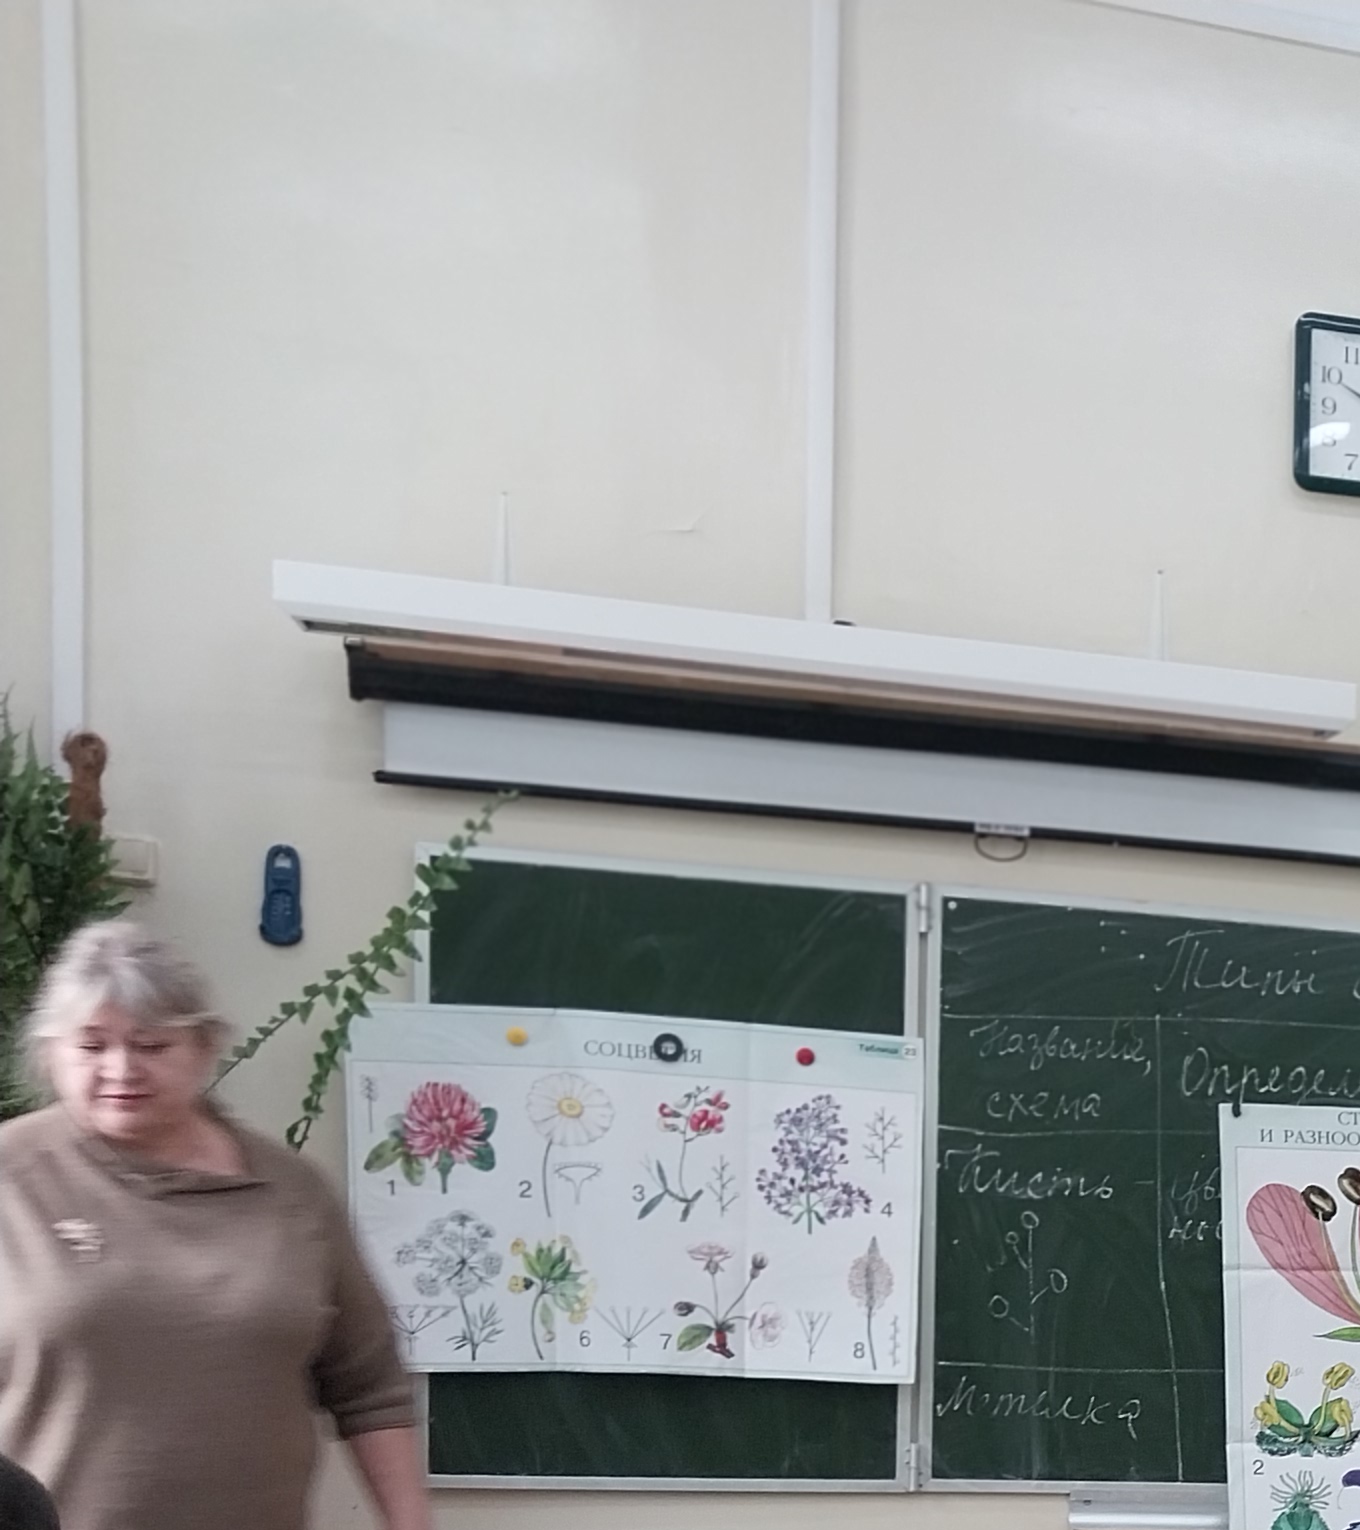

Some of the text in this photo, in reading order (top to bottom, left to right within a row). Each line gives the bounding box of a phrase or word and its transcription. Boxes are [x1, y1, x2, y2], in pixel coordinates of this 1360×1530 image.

[1343, 346, 1360, 365] 11
[1321, 365, 1343, 385] 10
[1321, 396, 1337, 416] 9
[1344, 453, 1359, 471] 7
[1155, 929, 1323, 997] Типы
[904, 1047, 917, 1057] 23
[985, 1091, 1101, 1122] схема
[1259, 1129, 1273, 1143] И
[387, 1181, 396, 1196] 1
[518, 1181, 533, 1199] 2
[633, 1185, 646, 1202] 3
[880, 1201, 894, 1218] 4
[578, 1329, 592, 1348] 6
[659, 1334, 673, 1351] 7
[853, 1342, 866, 1360] 8
[1253, 1460, 1264, 1475] 2
